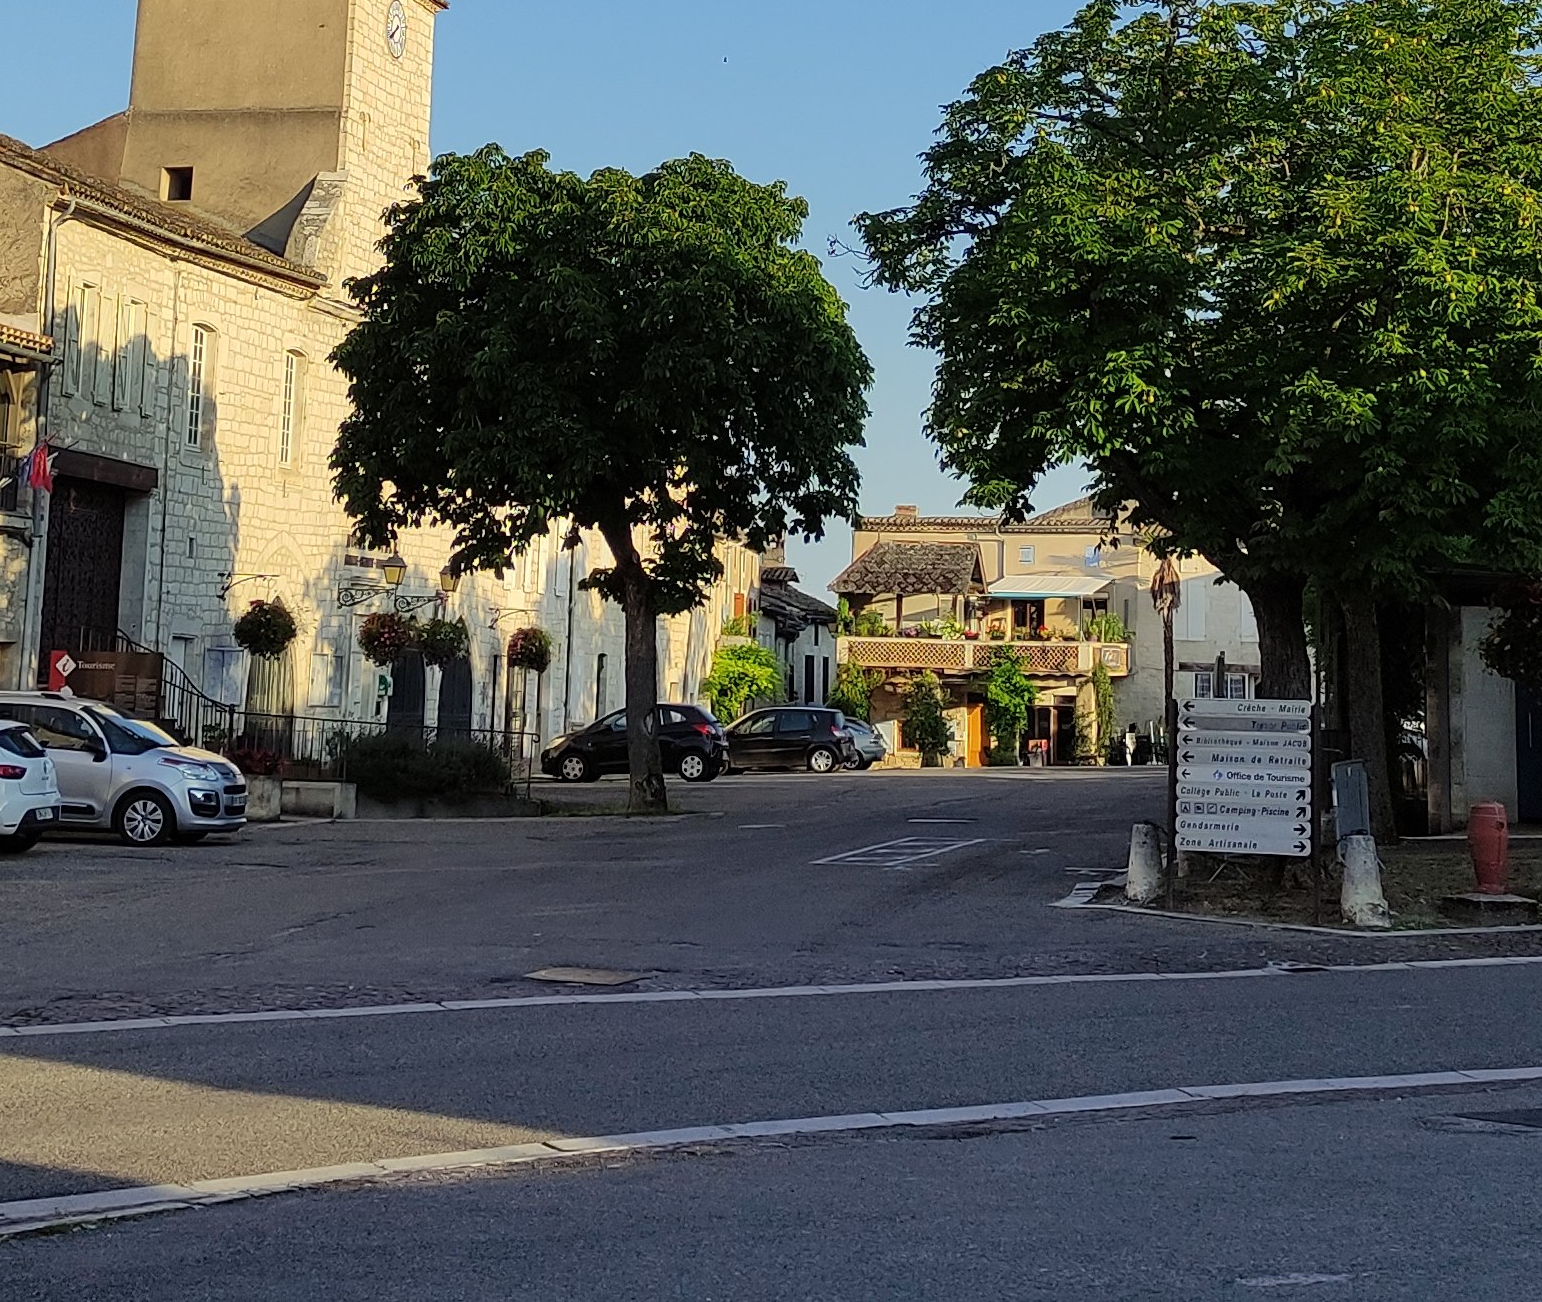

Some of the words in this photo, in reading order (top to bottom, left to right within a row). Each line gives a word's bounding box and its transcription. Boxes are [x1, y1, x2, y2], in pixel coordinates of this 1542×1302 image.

[77, 660, 115, 670] Tourisme
[1278, 705, 1306, 714] Mairie
[1281, 721, 1307, 731] Public
[1253, 739, 1279, 747] Maison
[1282, 740, 1307, 748] JACOB
[1211, 753, 1245, 763] Maison
[1251, 754, 1262, 764] de
[1268, 755, 1307, 765] Retraite
[1226, 771, 1251, 781] Office
[1253, 773, 1264, 781] de
[1266, 773, 1305, 783] Tourisme
[1180, 786, 1211, 798] Collège
[1214, 787, 1240, 797] Public
[1251, 788, 1261, 798] La
[1265, 789, 1288, 799] Poste
[1180, 820, 1240, 832] Gendarmerie
[1179, 837, 1202, 847] Zone
[1208, 838, 1258, 849] Artisanale
